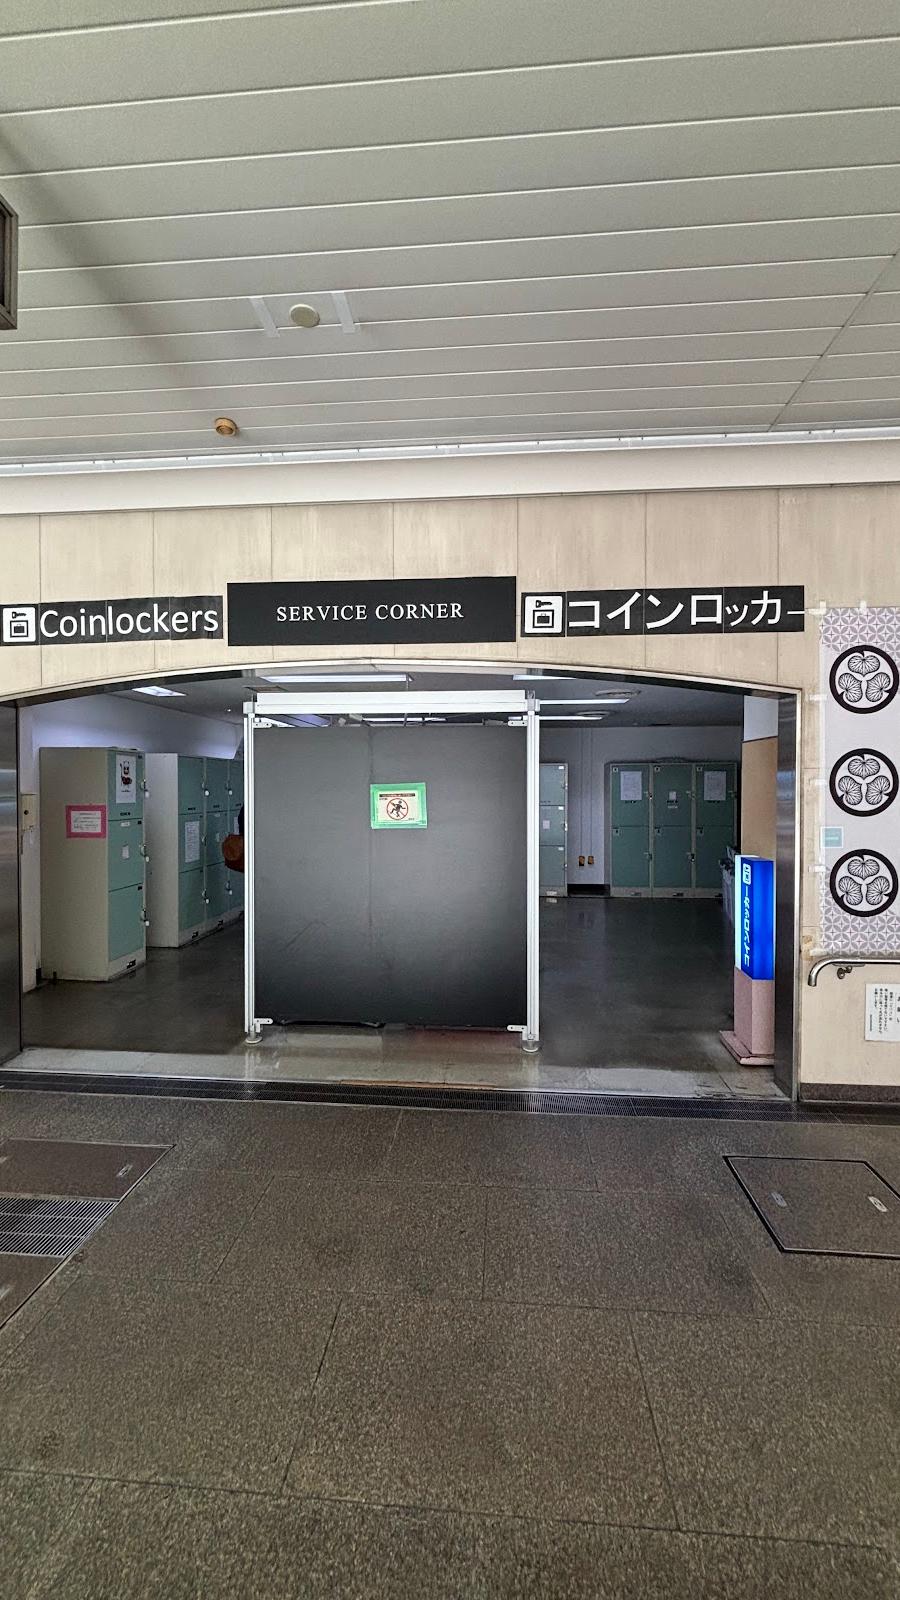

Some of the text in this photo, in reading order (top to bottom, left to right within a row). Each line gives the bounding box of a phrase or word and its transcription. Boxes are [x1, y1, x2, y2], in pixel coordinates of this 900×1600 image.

[39, 604, 219, 638] Coinlockers
[276, 602, 464, 622] SERVICE CORNER
[568, 590, 804, 630] コインロッカー
